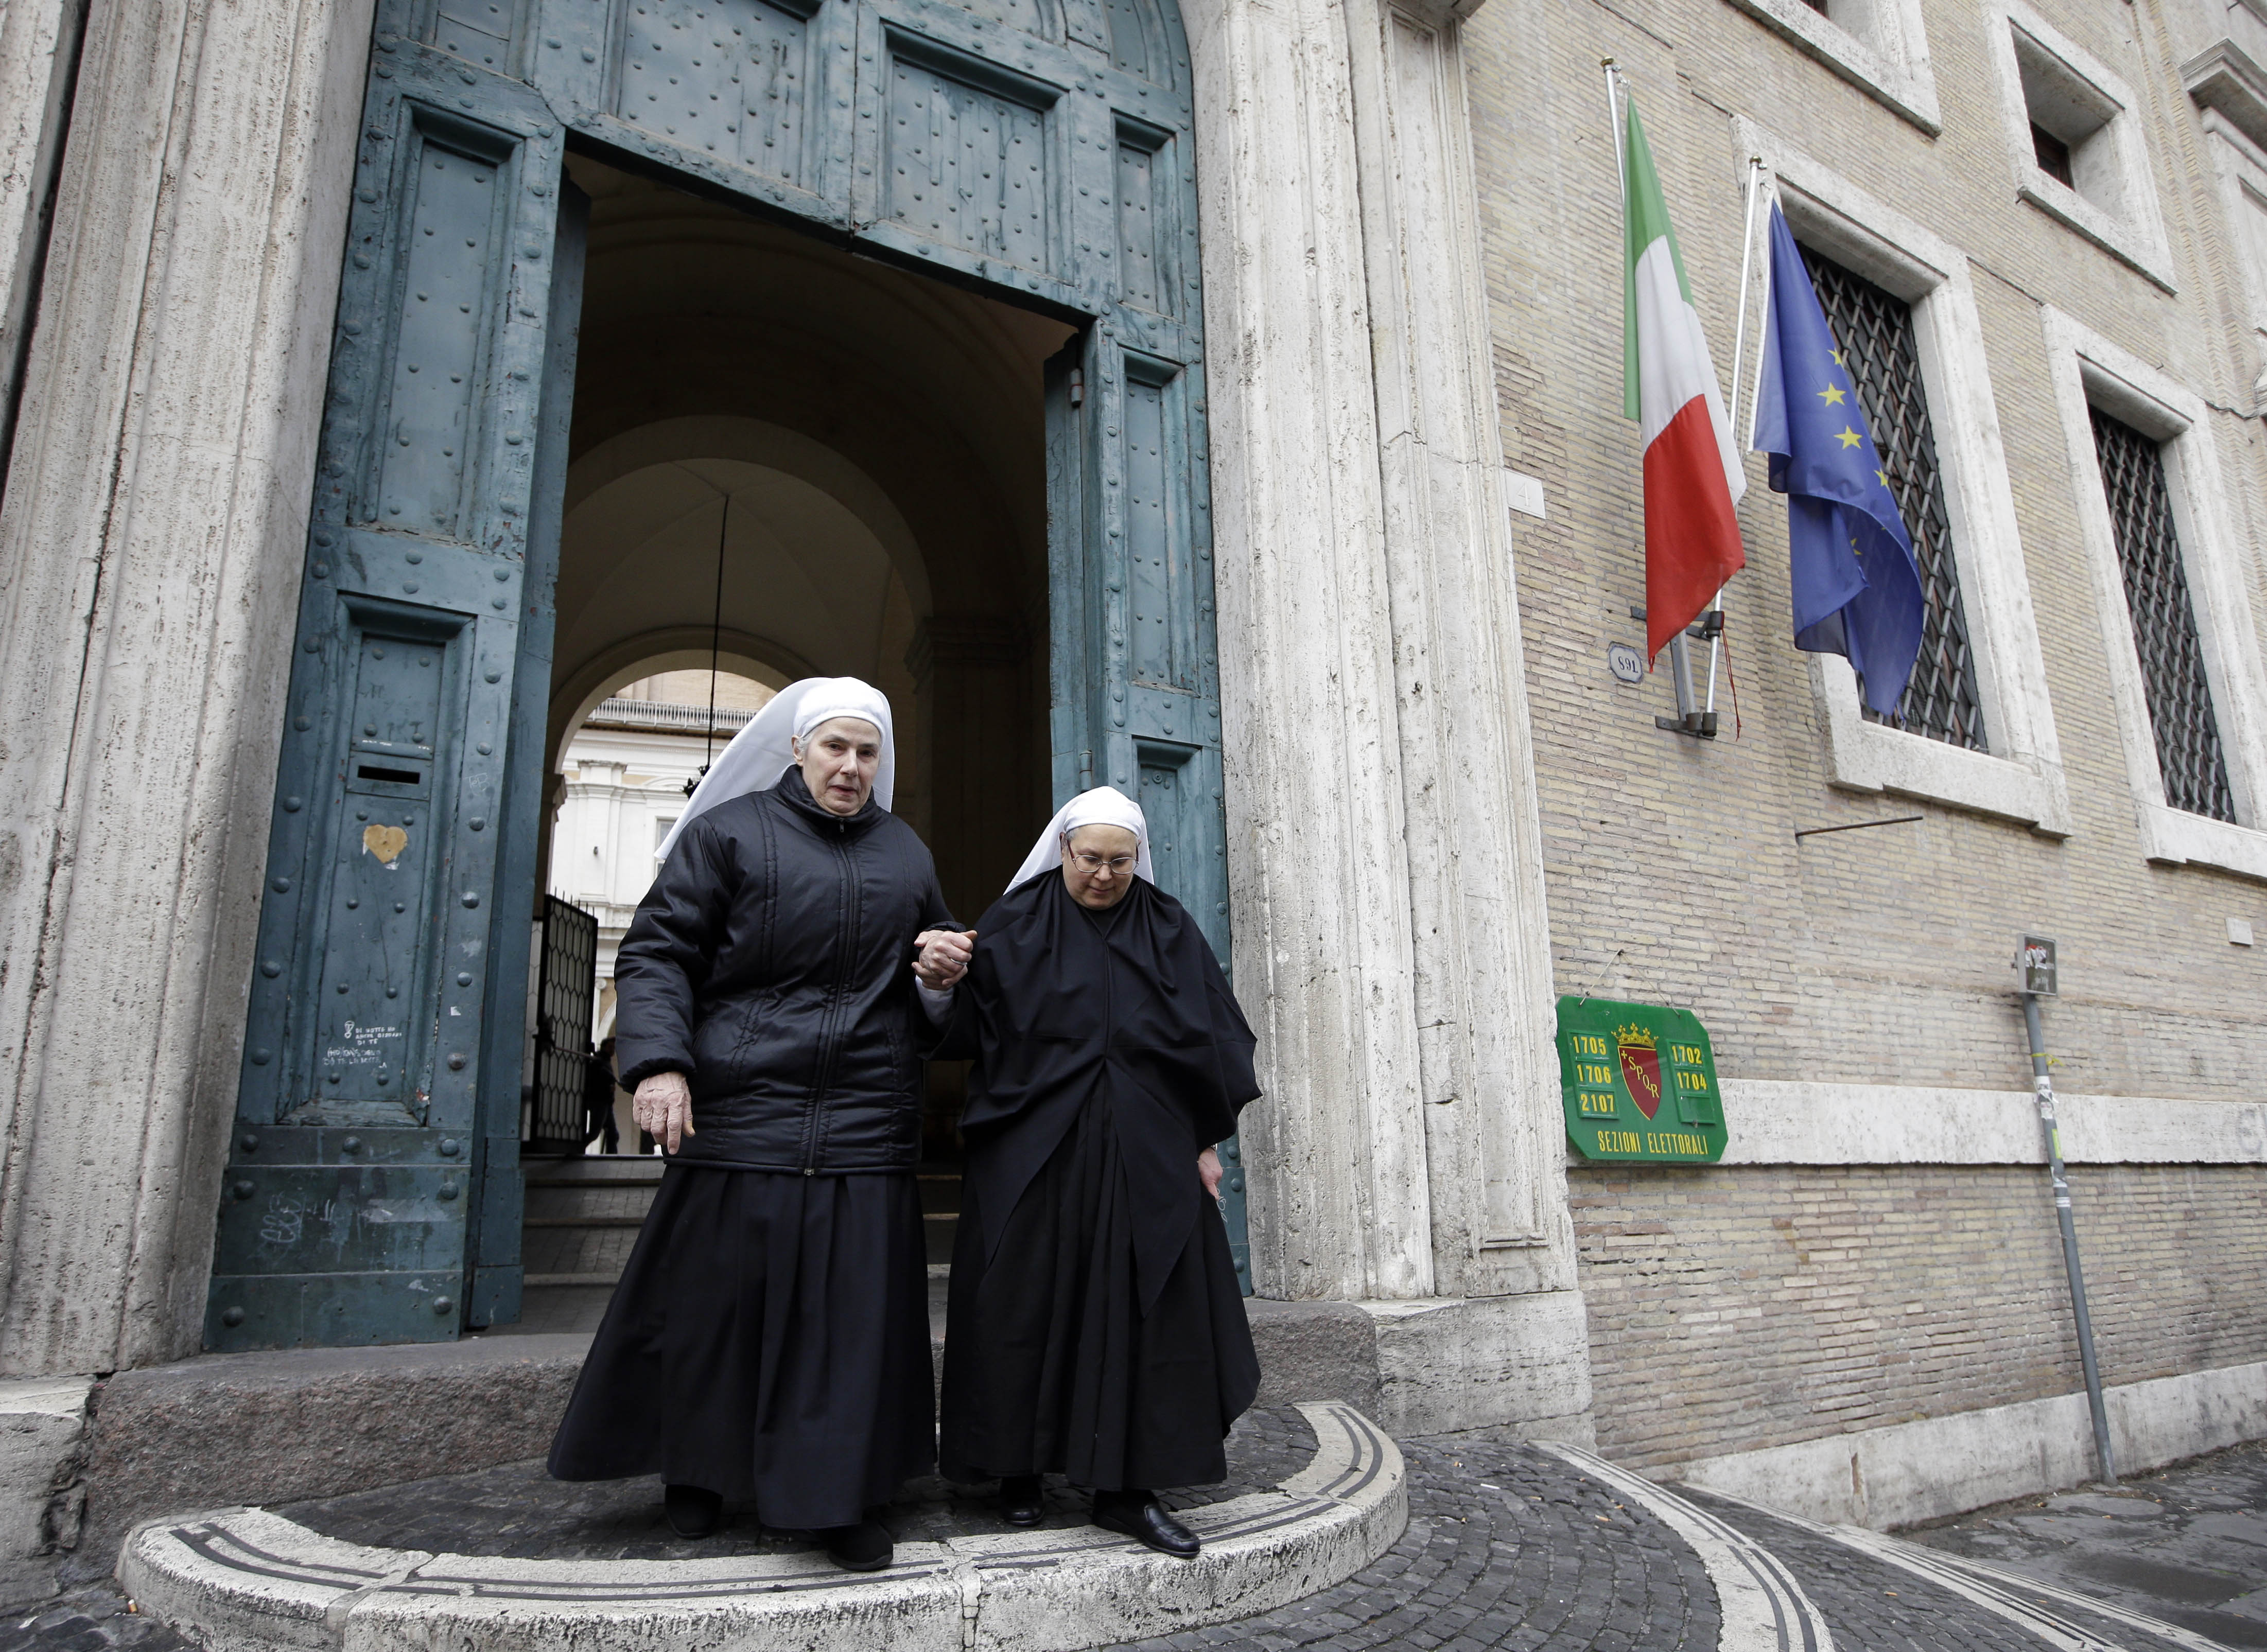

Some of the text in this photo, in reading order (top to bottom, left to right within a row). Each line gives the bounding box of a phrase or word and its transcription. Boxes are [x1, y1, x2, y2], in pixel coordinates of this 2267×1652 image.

[1573, 1036, 1607, 1055] 1705
[1672, 1046, 1702, 1064] 1702
[1577, 1064, 1612, 1084] 1706
[1628, 1056, 1660, 1098] SPQR
[1677, 1072, 1707, 1091] 1704
[1580, 1094, 1615, 1112] 2107
[1598, 1131, 1708, 1155] SEZIONI ELETTORALI
